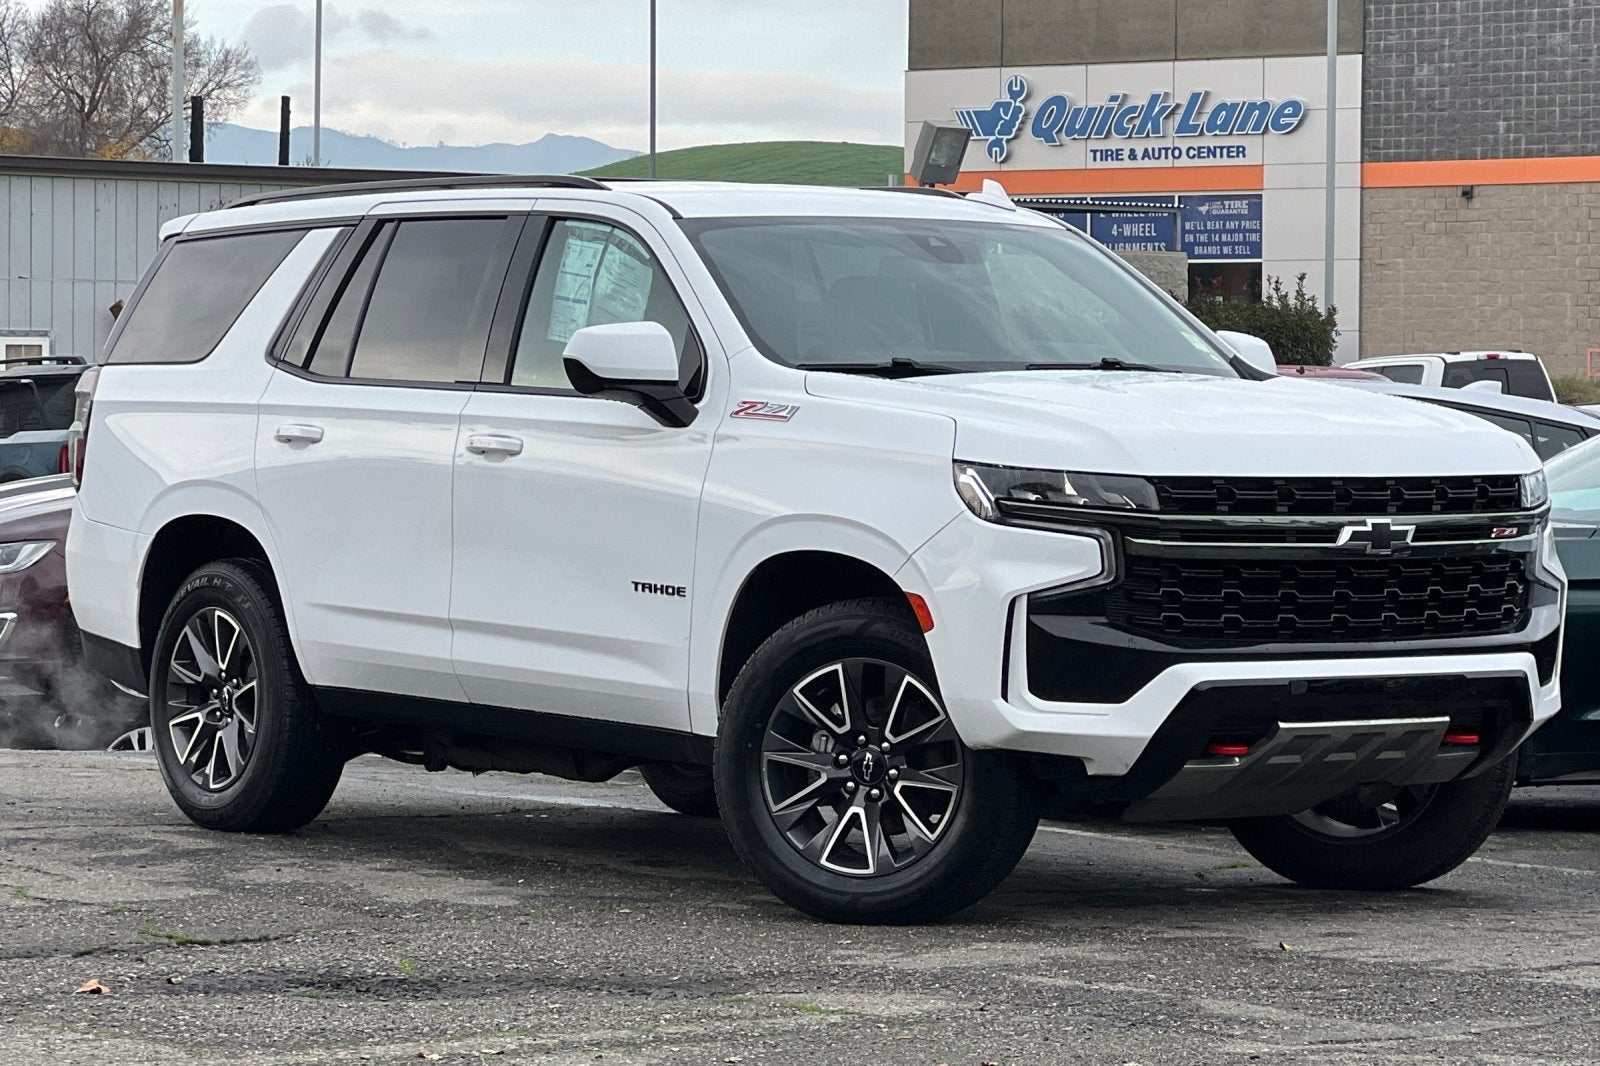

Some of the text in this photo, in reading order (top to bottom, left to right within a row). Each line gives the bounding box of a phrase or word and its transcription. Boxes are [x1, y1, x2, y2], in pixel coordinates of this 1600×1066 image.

[1030, 89, 1305, 146] Quick Lane
[1090, 145, 1247, 162] TIRE & AUTO CENTER
[1223, 200, 1249, 209] TIRE
[1111, 223, 1157, 237] 4-WHEEL
[1184, 220, 1261, 230] WE'LL BEAT ANY PRICE
[1184, 232, 1261, 243] ON THE 14 MAJOR TIRE
[1194, 245, 1251, 255] BRANDS WE SELL
[729, 400, 801, 422] Z71
[630, 580, 687, 598] TAHOE
